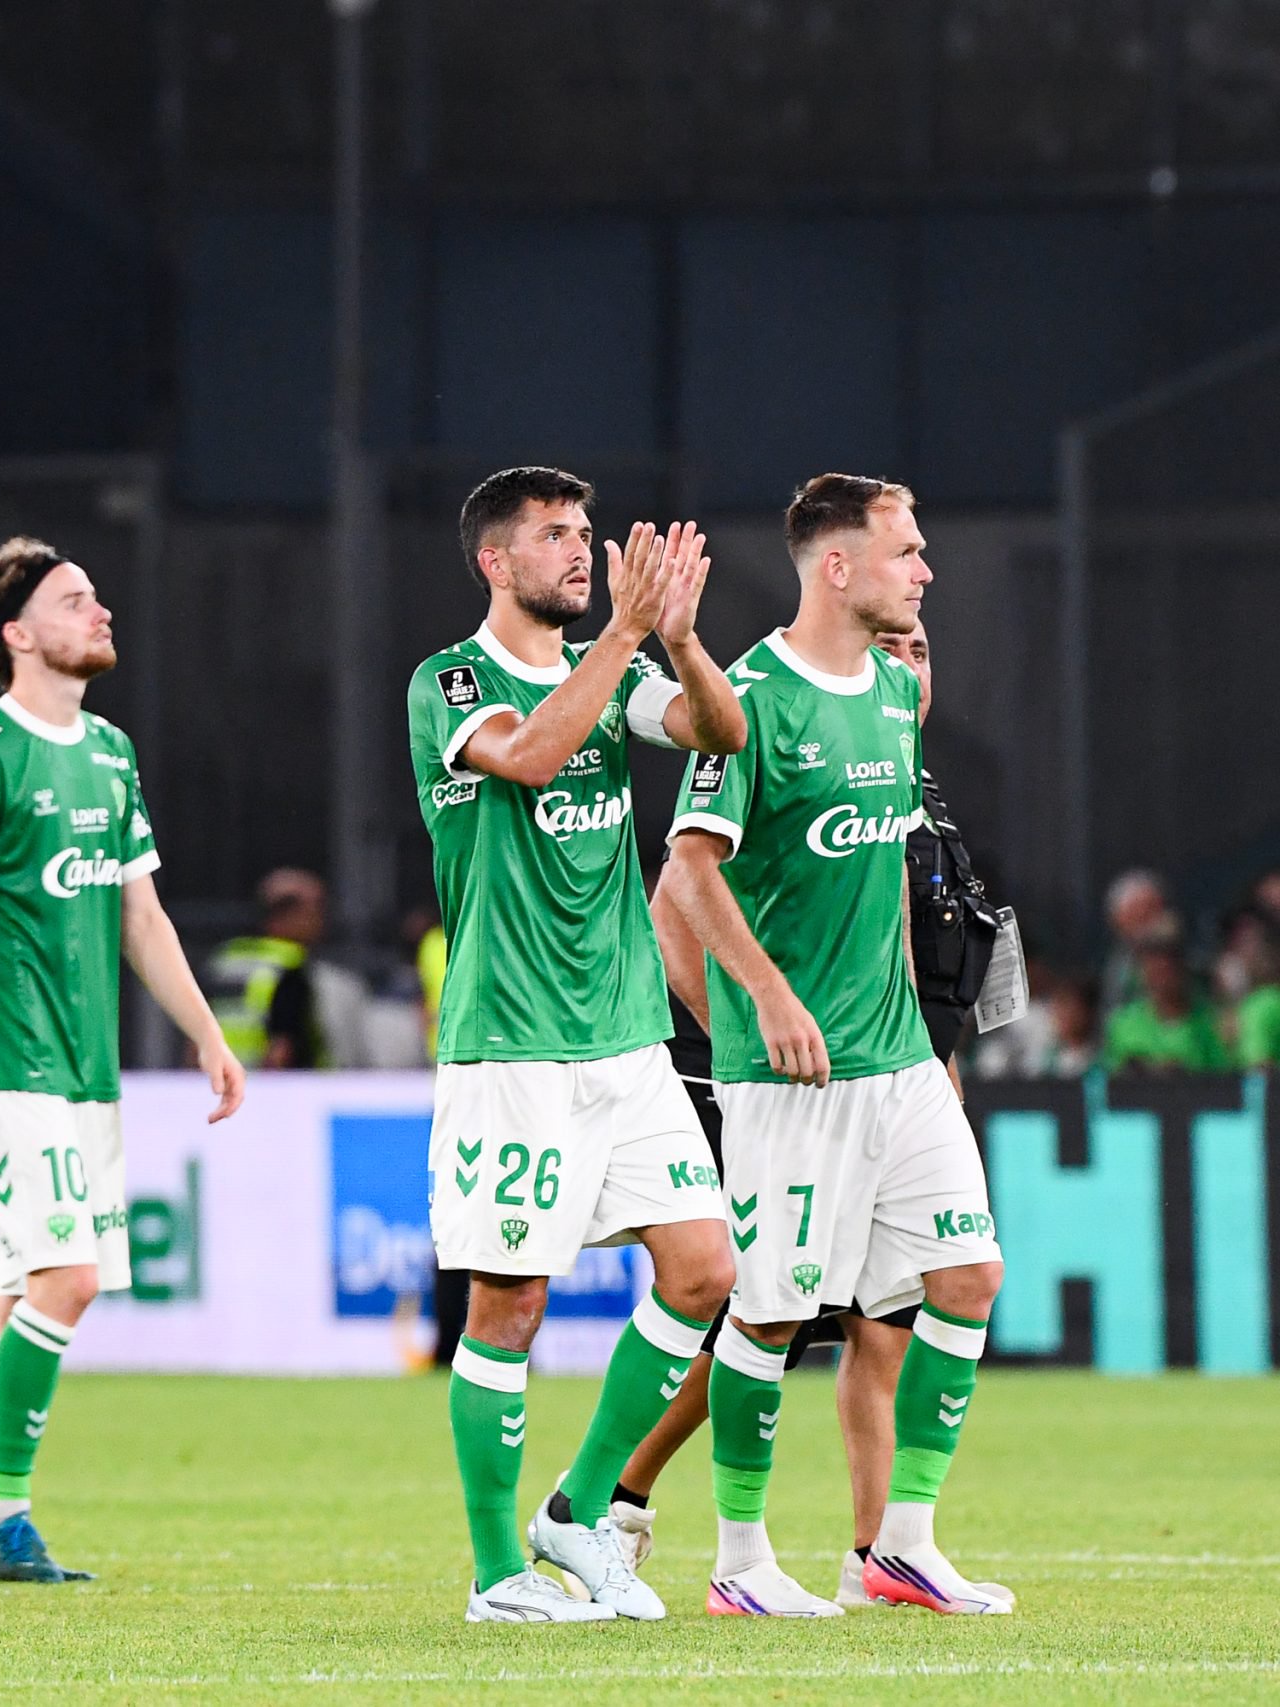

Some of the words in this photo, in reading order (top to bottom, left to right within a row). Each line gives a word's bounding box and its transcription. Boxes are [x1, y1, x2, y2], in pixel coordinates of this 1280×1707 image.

[845, 760, 896, 780] Loire
[806, 804, 908, 858] Casin
[42, 1146, 88, 1202] 10
[494, 1142, 562, 1210] 26
[787, 1184, 815, 1247] 7
